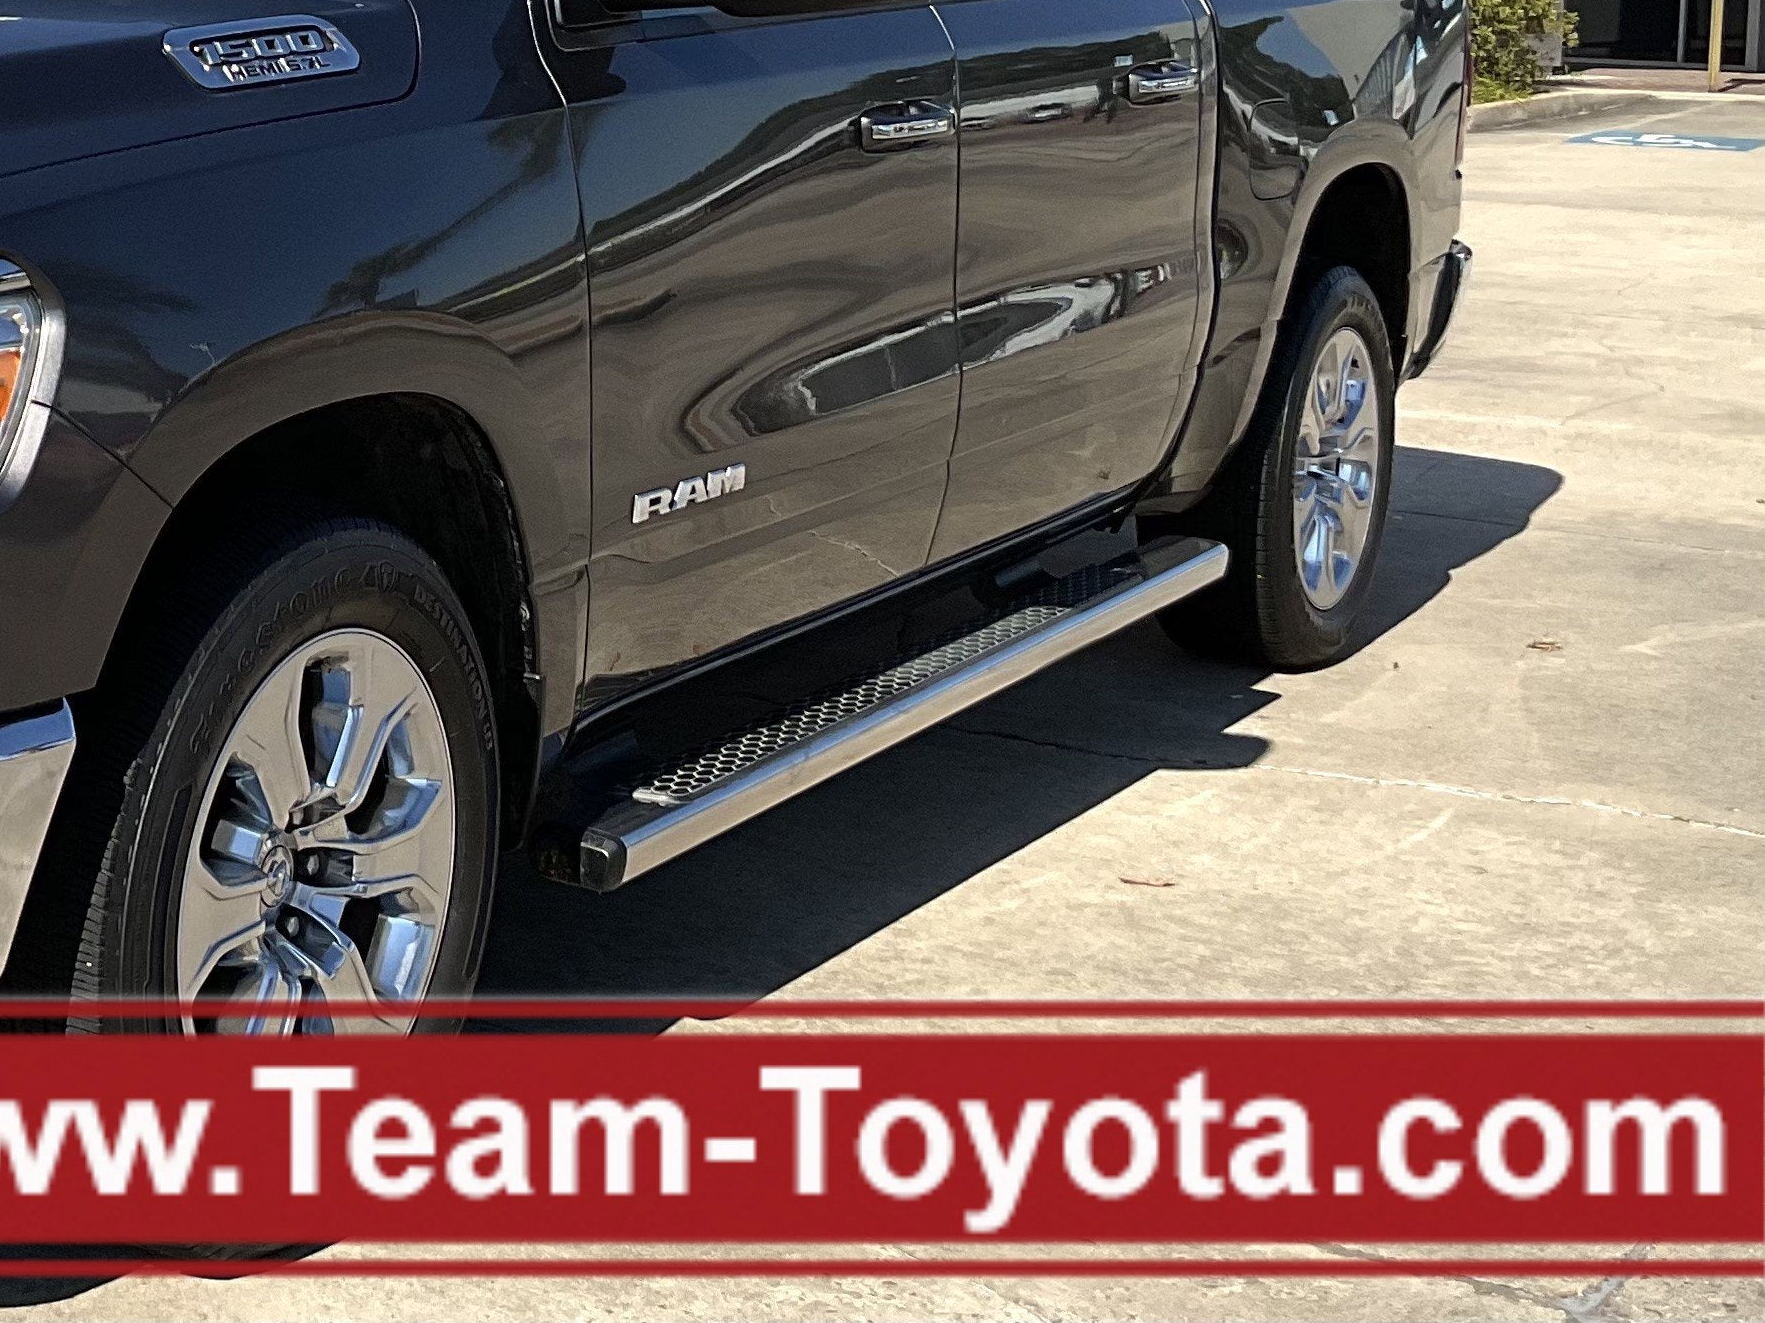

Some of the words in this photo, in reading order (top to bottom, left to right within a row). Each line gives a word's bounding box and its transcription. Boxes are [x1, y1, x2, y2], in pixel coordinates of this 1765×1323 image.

[194, 29, 325, 72] 1500
[223, 58, 288, 82] HEMI
[288, 55, 332, 75] 5.7L
[632, 463, 746, 524] RAM
